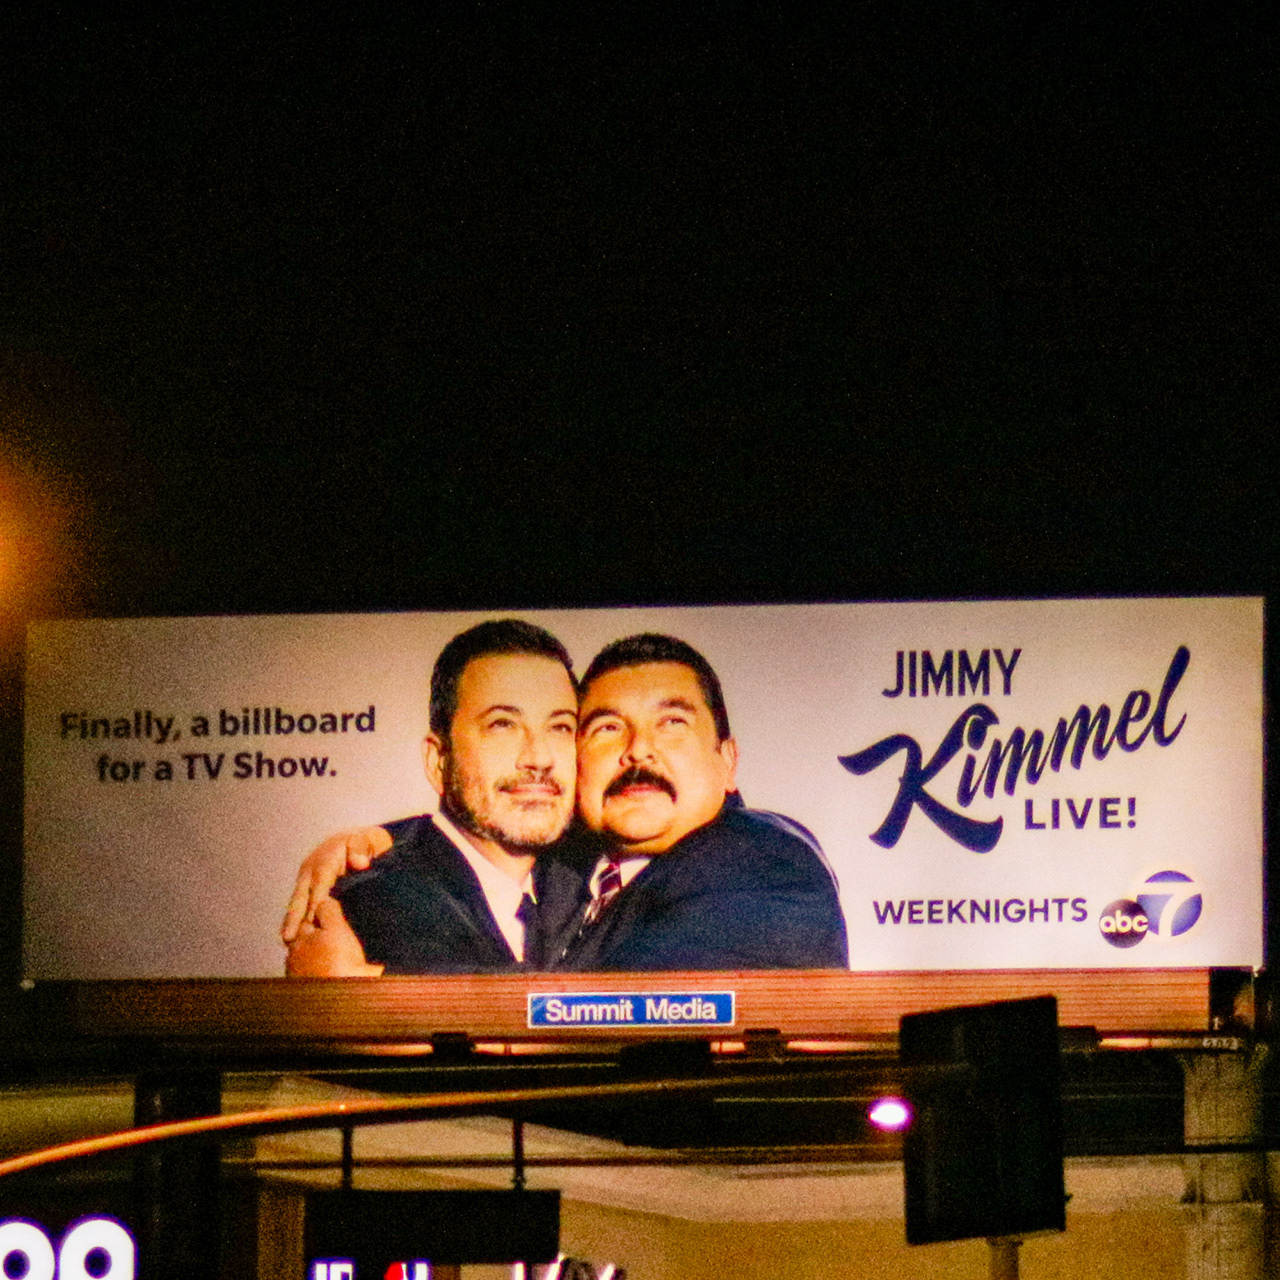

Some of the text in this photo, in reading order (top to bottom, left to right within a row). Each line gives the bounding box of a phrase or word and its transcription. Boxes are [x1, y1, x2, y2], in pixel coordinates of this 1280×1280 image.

[882, 649, 1022, 698] JIMMY
[60, 705, 375, 744] Finally, a billboard
[97, 750, 338, 782] for a TV Show.
[837, 645, 1190, 853] Kimmel
[1024, 797, 1137, 830] LIVE!
[872, 897, 1088, 925] WEEKNIGHTS
[1099, 874, 1203, 937] abc 7
[545, 998, 717, 1022] Summit Media
